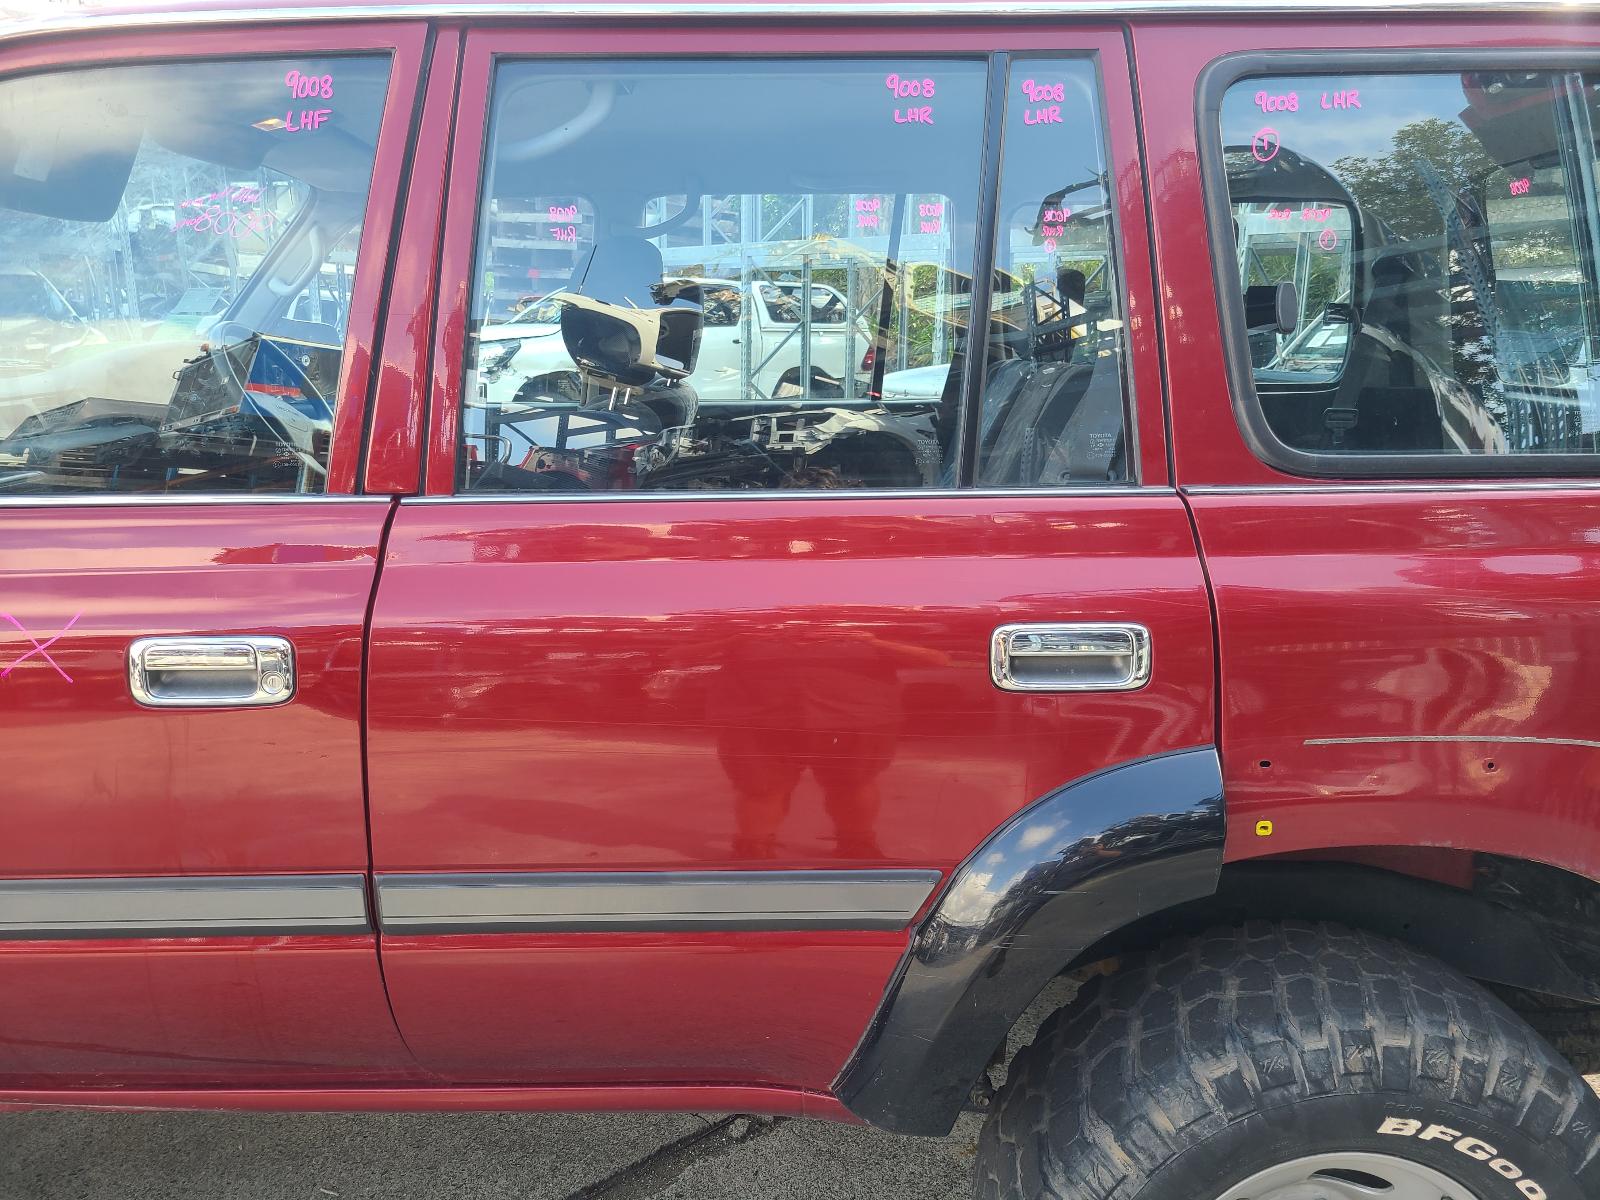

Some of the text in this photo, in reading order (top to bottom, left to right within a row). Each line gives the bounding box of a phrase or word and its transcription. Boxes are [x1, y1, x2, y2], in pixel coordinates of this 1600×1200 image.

[285, 70, 334, 99] 9008
[886, 74, 935, 98] 9008
[1022, 80, 1065, 102] 9008
[1254, 90, 1361, 113] 9008 LHR
[285, 109, 333, 132] LHF
[894, 106, 934, 125] LHR
[1024, 105, 1063, 125] LHR
